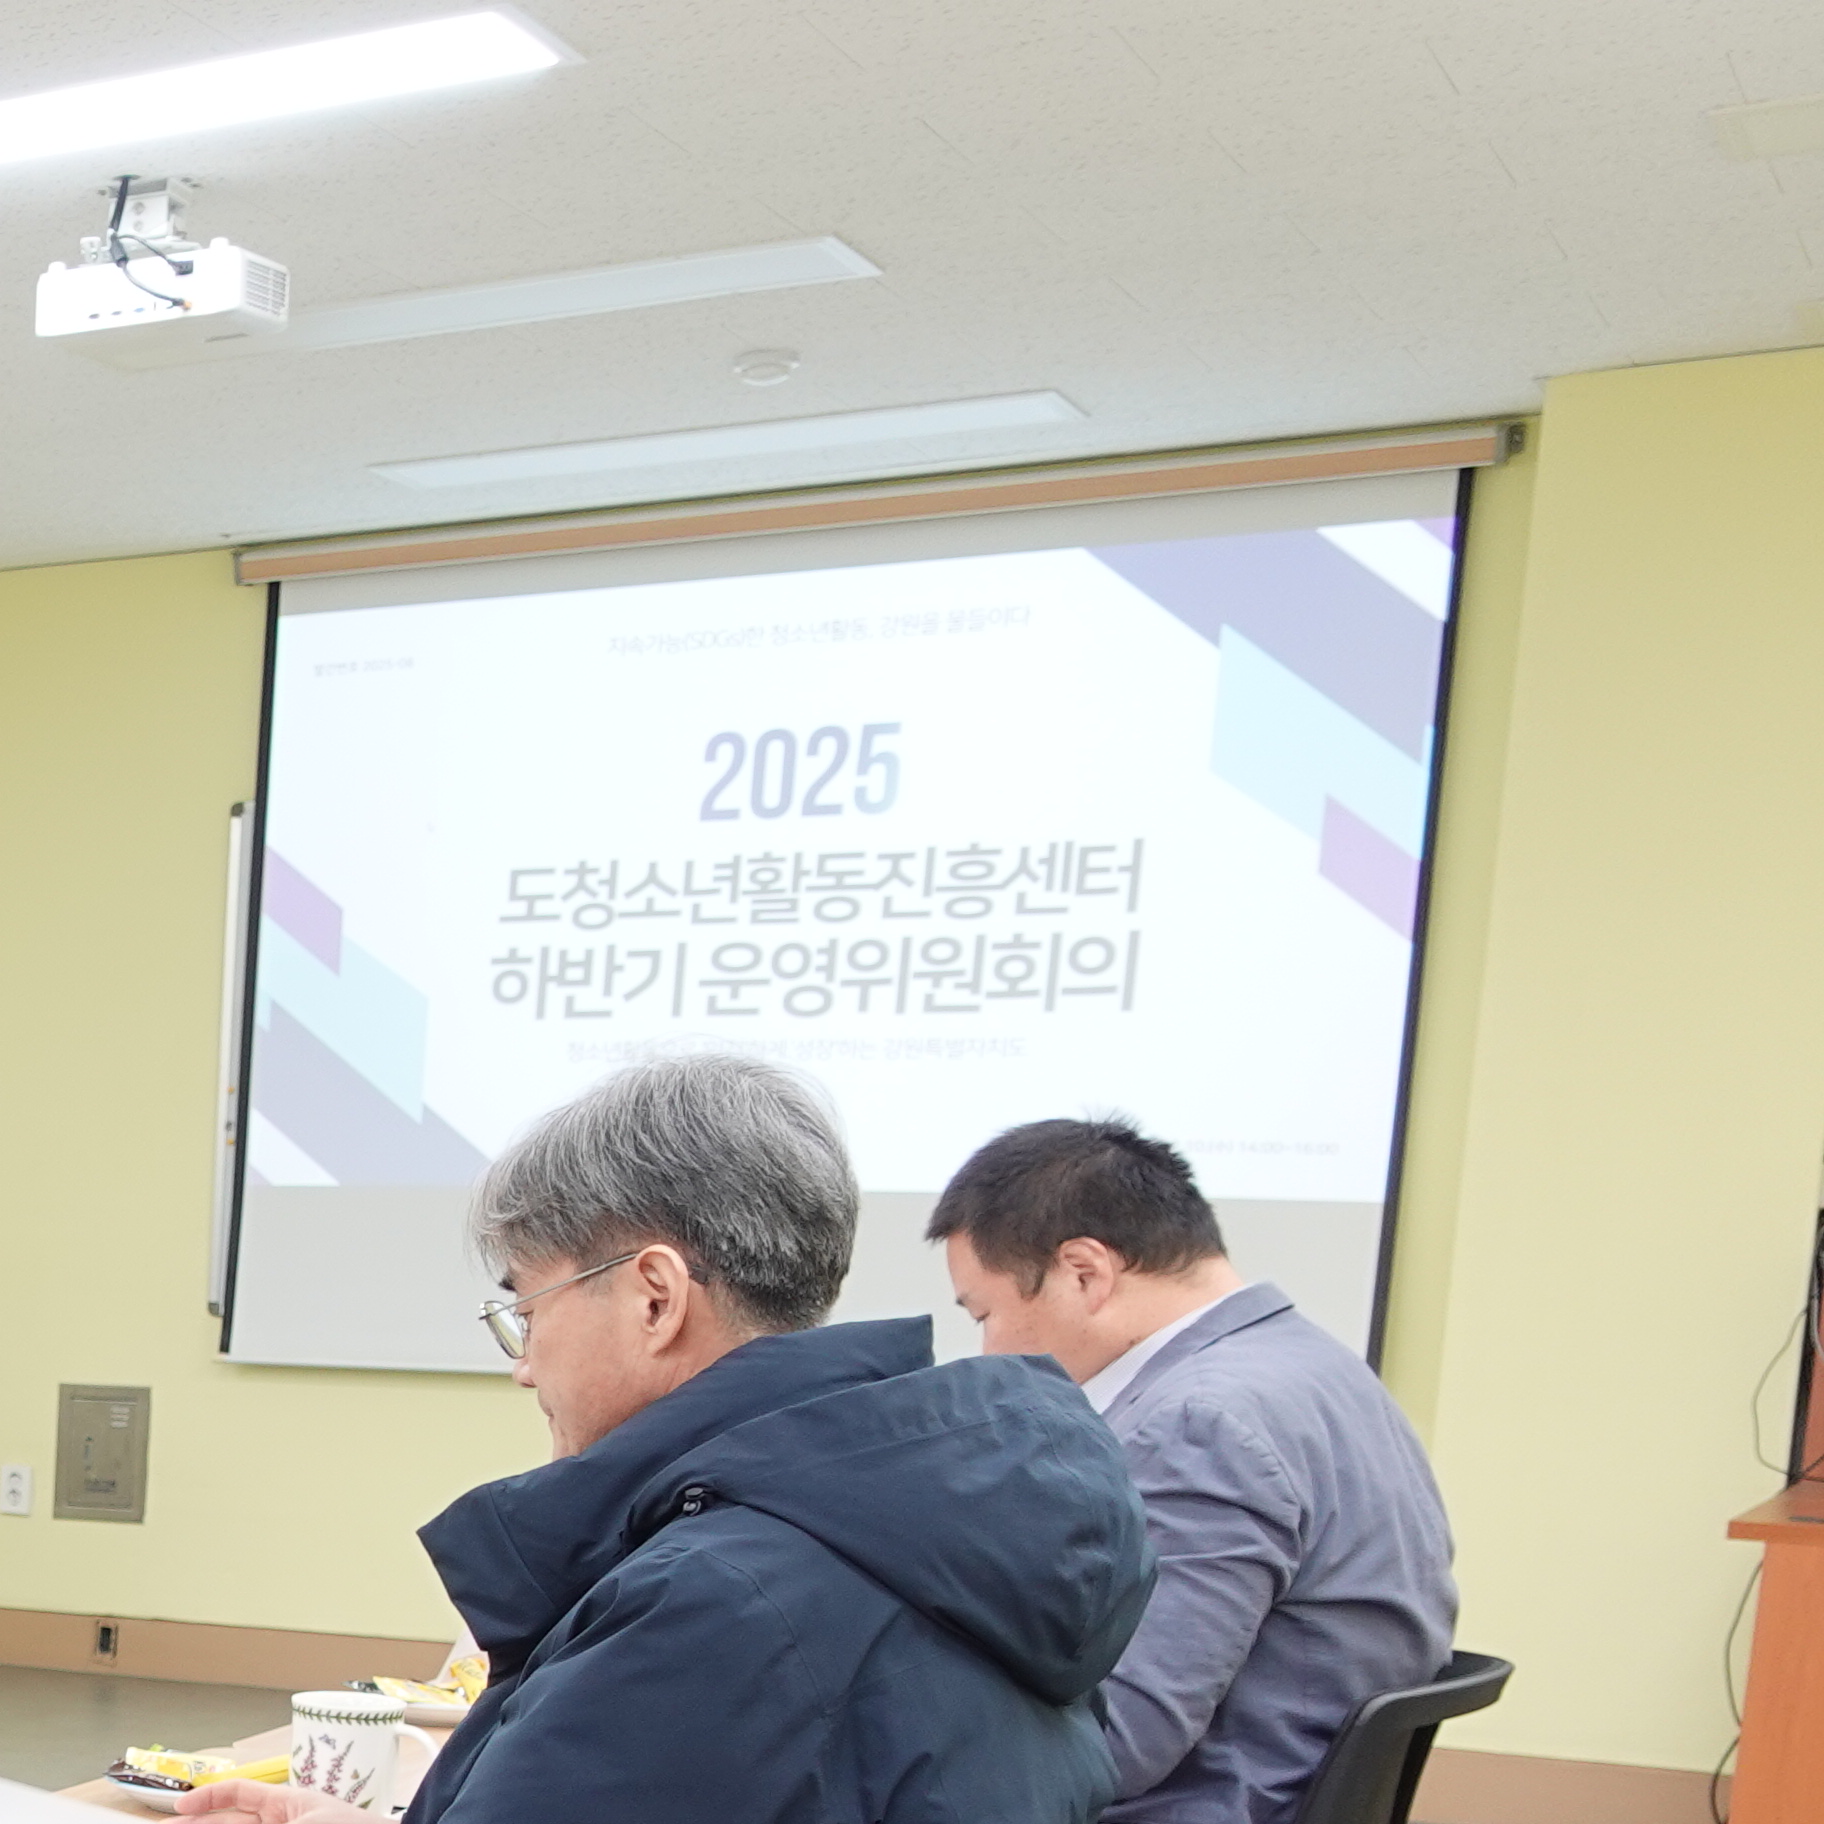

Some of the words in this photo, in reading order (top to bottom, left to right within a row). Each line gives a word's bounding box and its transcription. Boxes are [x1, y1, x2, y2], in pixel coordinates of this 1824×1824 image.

[699, 721, 902, 822] 2025
[498, 837, 1146, 931] 도청소년활동진흥센터
[490, 940, 688, 1020] 하반기
[698, 929, 1142, 1018] 운영위원회의
